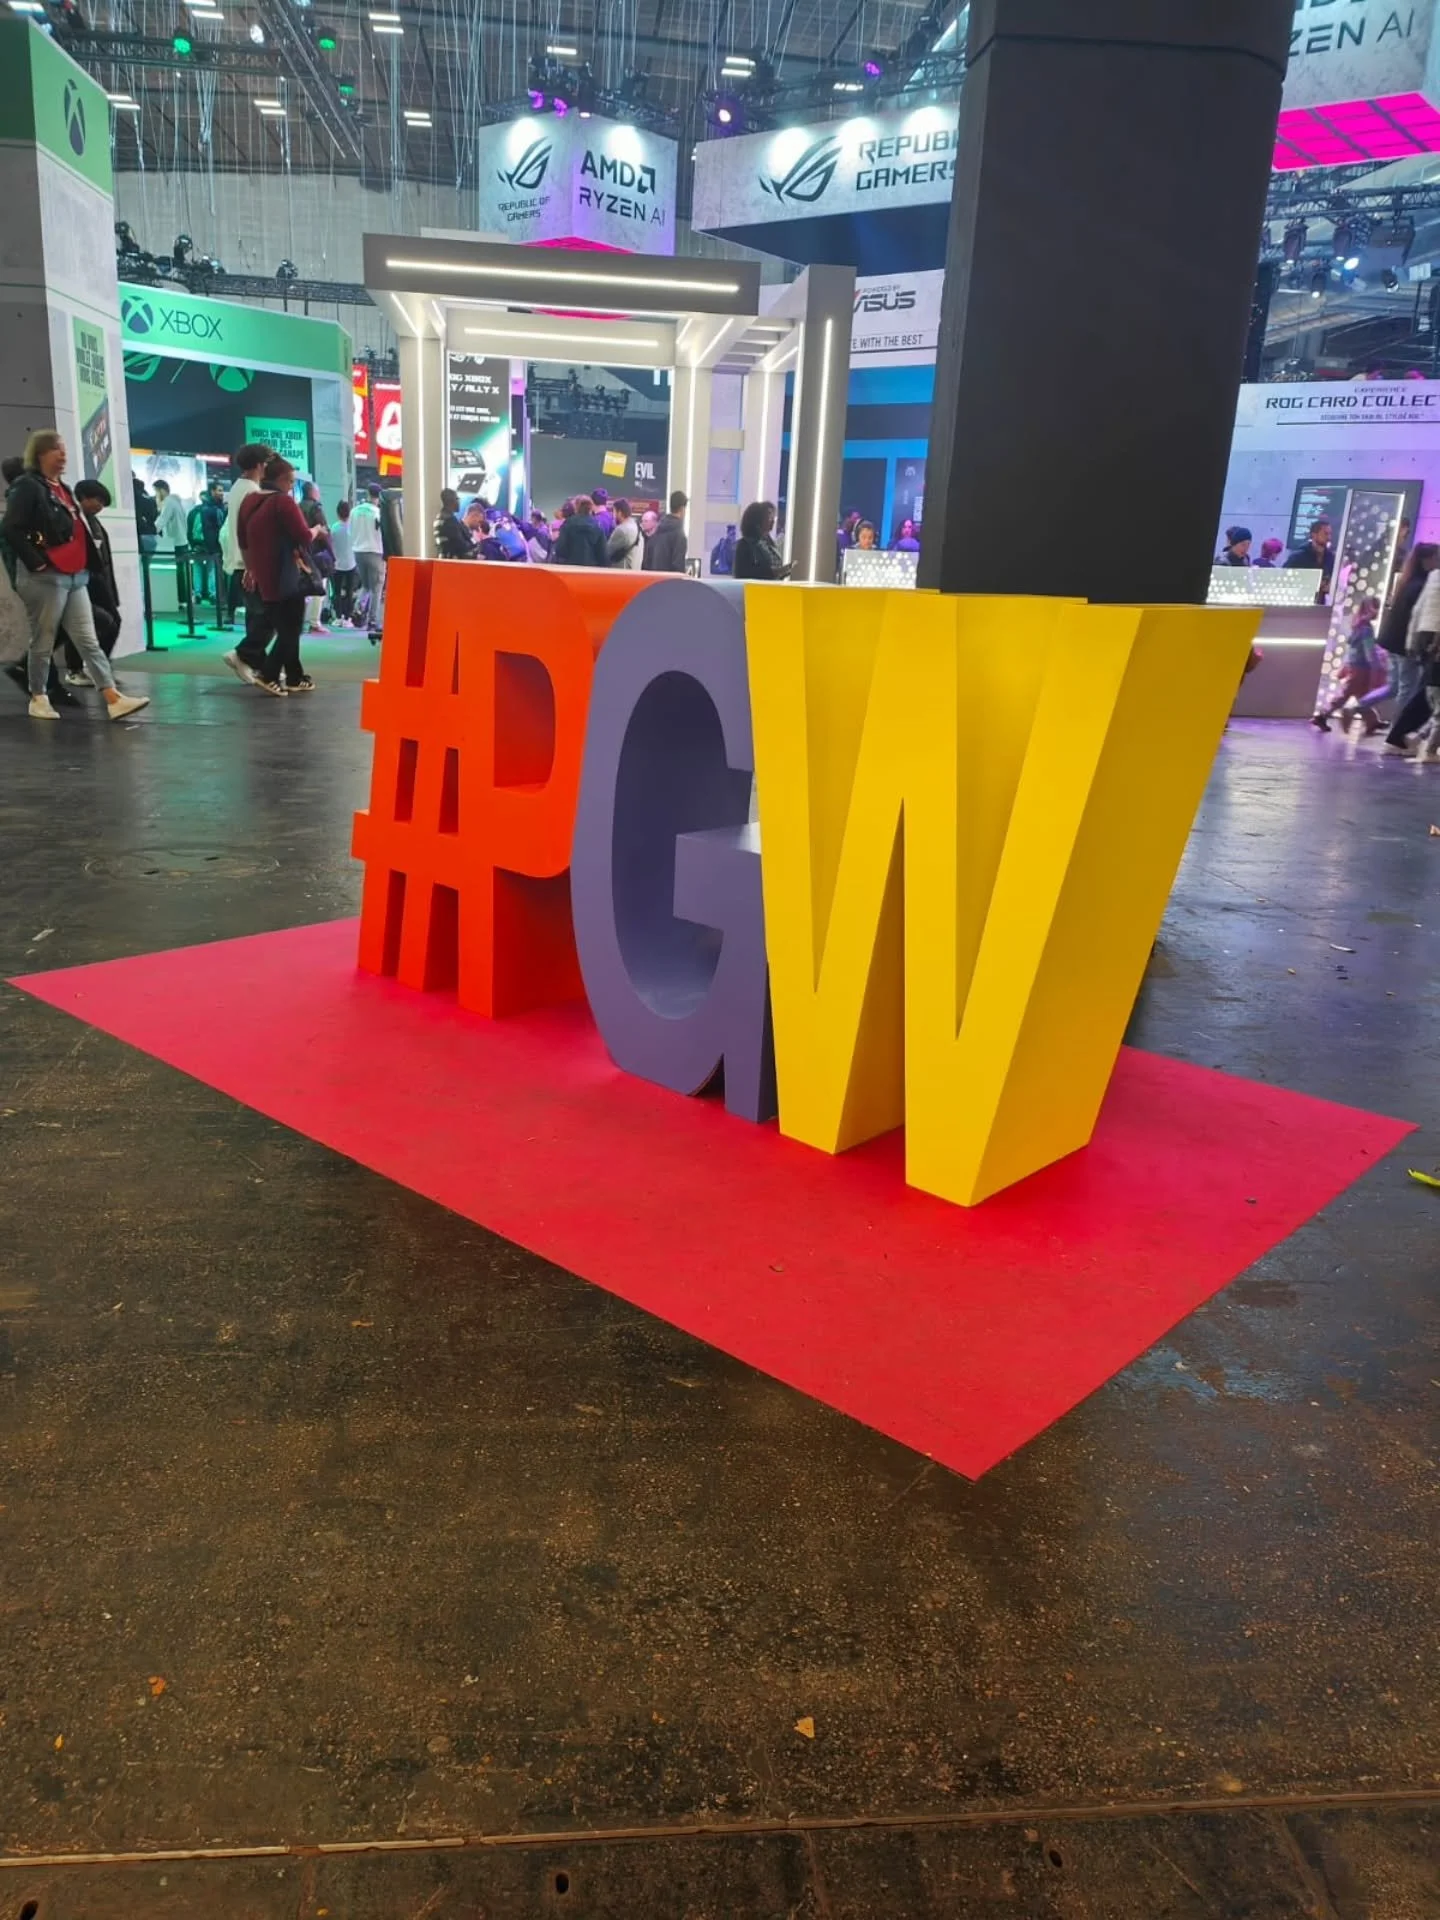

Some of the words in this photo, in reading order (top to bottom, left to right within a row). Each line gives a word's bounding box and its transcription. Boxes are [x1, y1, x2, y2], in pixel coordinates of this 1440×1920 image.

[1376, 9, 1415, 43] AI
[580, 149, 635, 188] AMD
[498, 200, 537, 212] REPUBLIC
[579, 187, 646, 221] RYZEN
[650, 209, 666, 227] AI
[159, 307, 223, 342] XBOX
[860, 337, 881, 349] WITH
[884, 336, 899, 347] THE
[901, 334, 923, 346] BEST
[1266, 397, 1304, 409] ROG
[1307, 396, 1358, 408] CARD
[1362, 394, 1440, 407] COLLEC
[635, 461, 656, 480] EVIL
[352, 556, 1262, 1208] #PGW
